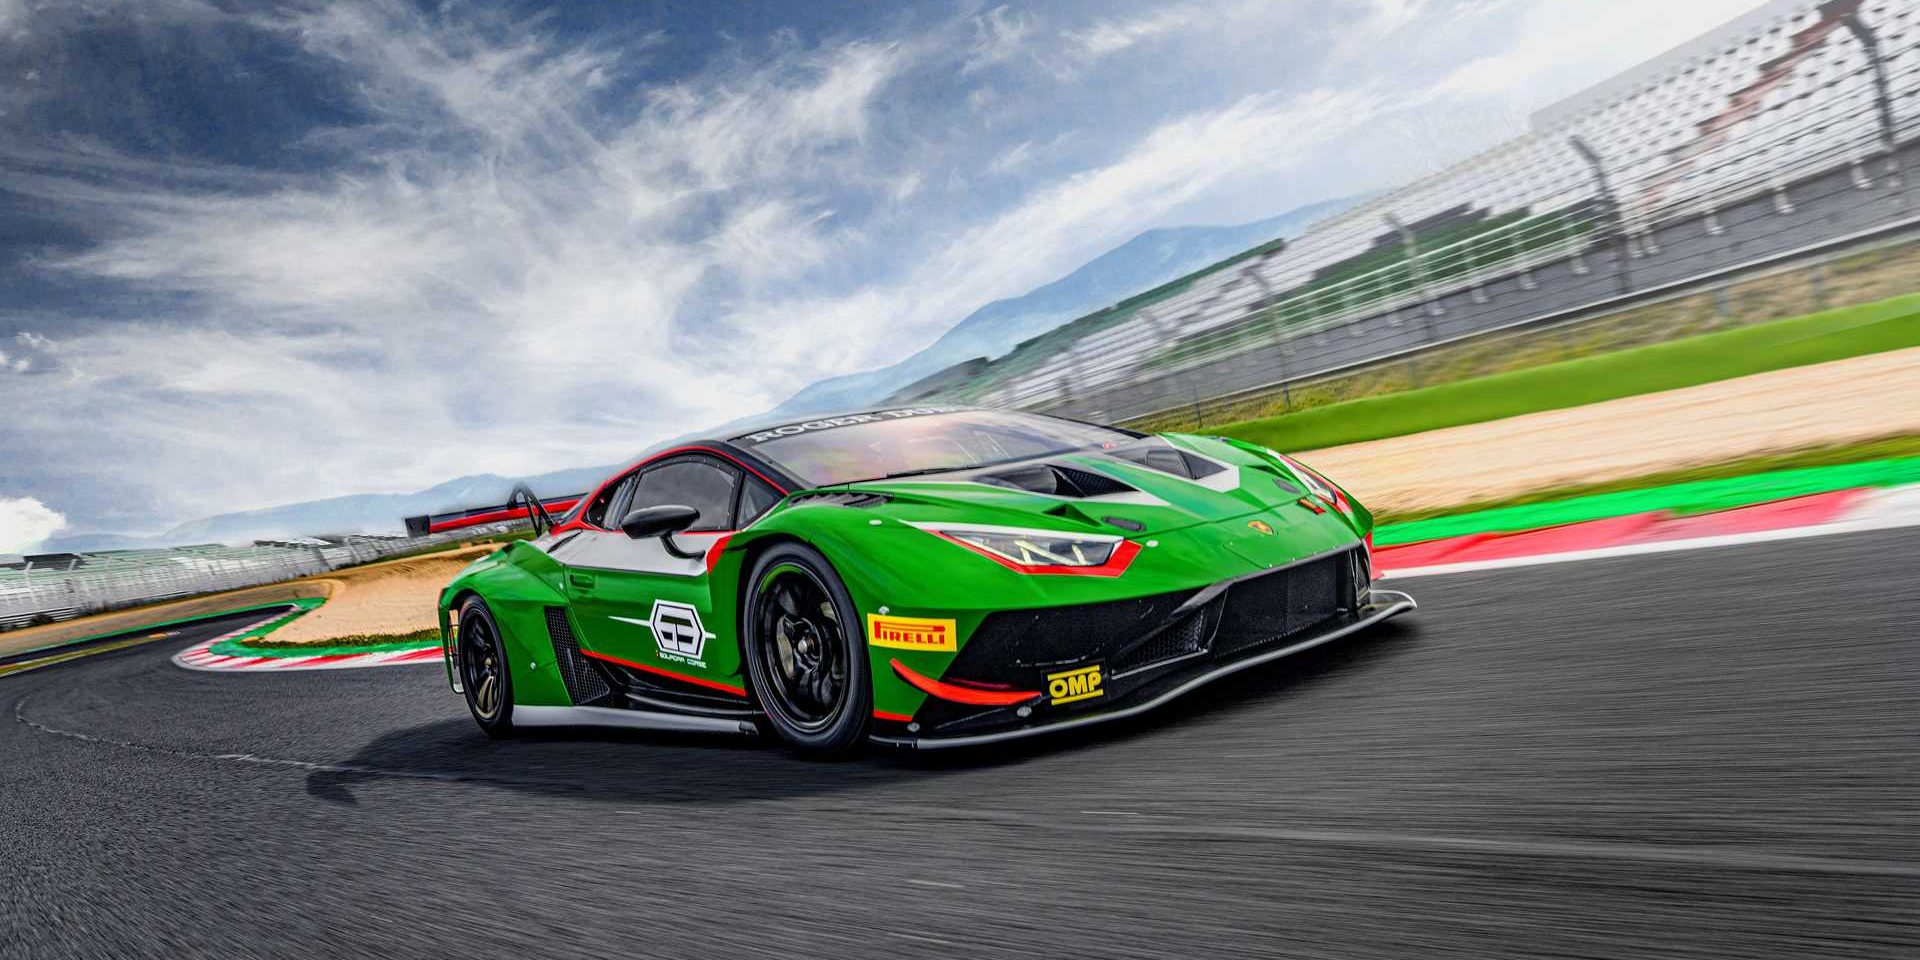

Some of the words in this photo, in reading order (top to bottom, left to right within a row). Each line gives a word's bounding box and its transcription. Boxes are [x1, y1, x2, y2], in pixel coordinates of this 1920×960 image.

[745, 414, 883, 442] ROGER
[874, 621, 945, 645] PIRELLI
[1049, 671, 1102, 699] OMP
